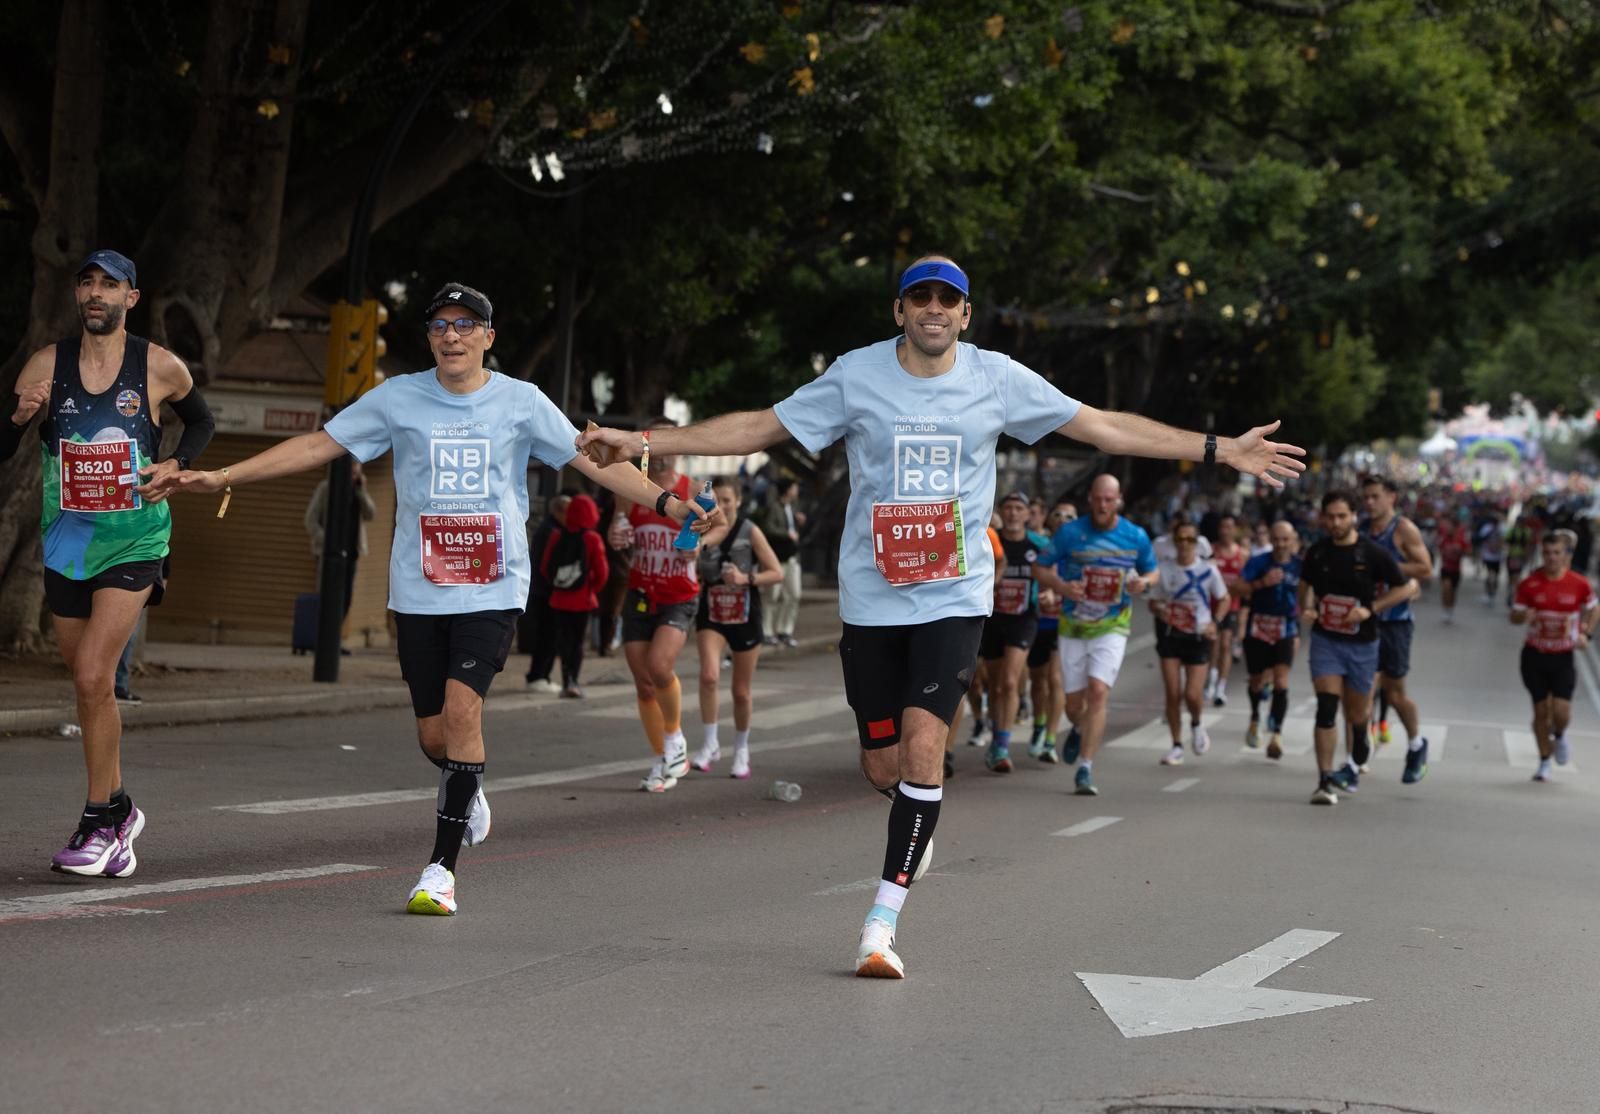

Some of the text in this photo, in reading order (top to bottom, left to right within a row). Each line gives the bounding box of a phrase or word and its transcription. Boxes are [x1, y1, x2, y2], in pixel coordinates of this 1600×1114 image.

[895, 414, 960, 424] new balance
[448, 428, 469, 436] club
[895, 423, 937, 432] run club
[75, 443, 124, 455] GENERALI
[904, 446, 951, 465] NB
[440, 448, 481, 467] NB
[75, 460, 113, 474] 3620
[439, 471, 480, 490] RC
[904, 469, 949, 491] RC
[430, 501, 484, 510] Casablanca
[893, 504, 949, 518] GENERALI
[440, 516, 490, 527] GENERALI
[435, 532, 484, 545] 10459
[892, 523, 936, 540] 9719
[903, 813, 923, 871] COMPRESSPORT
